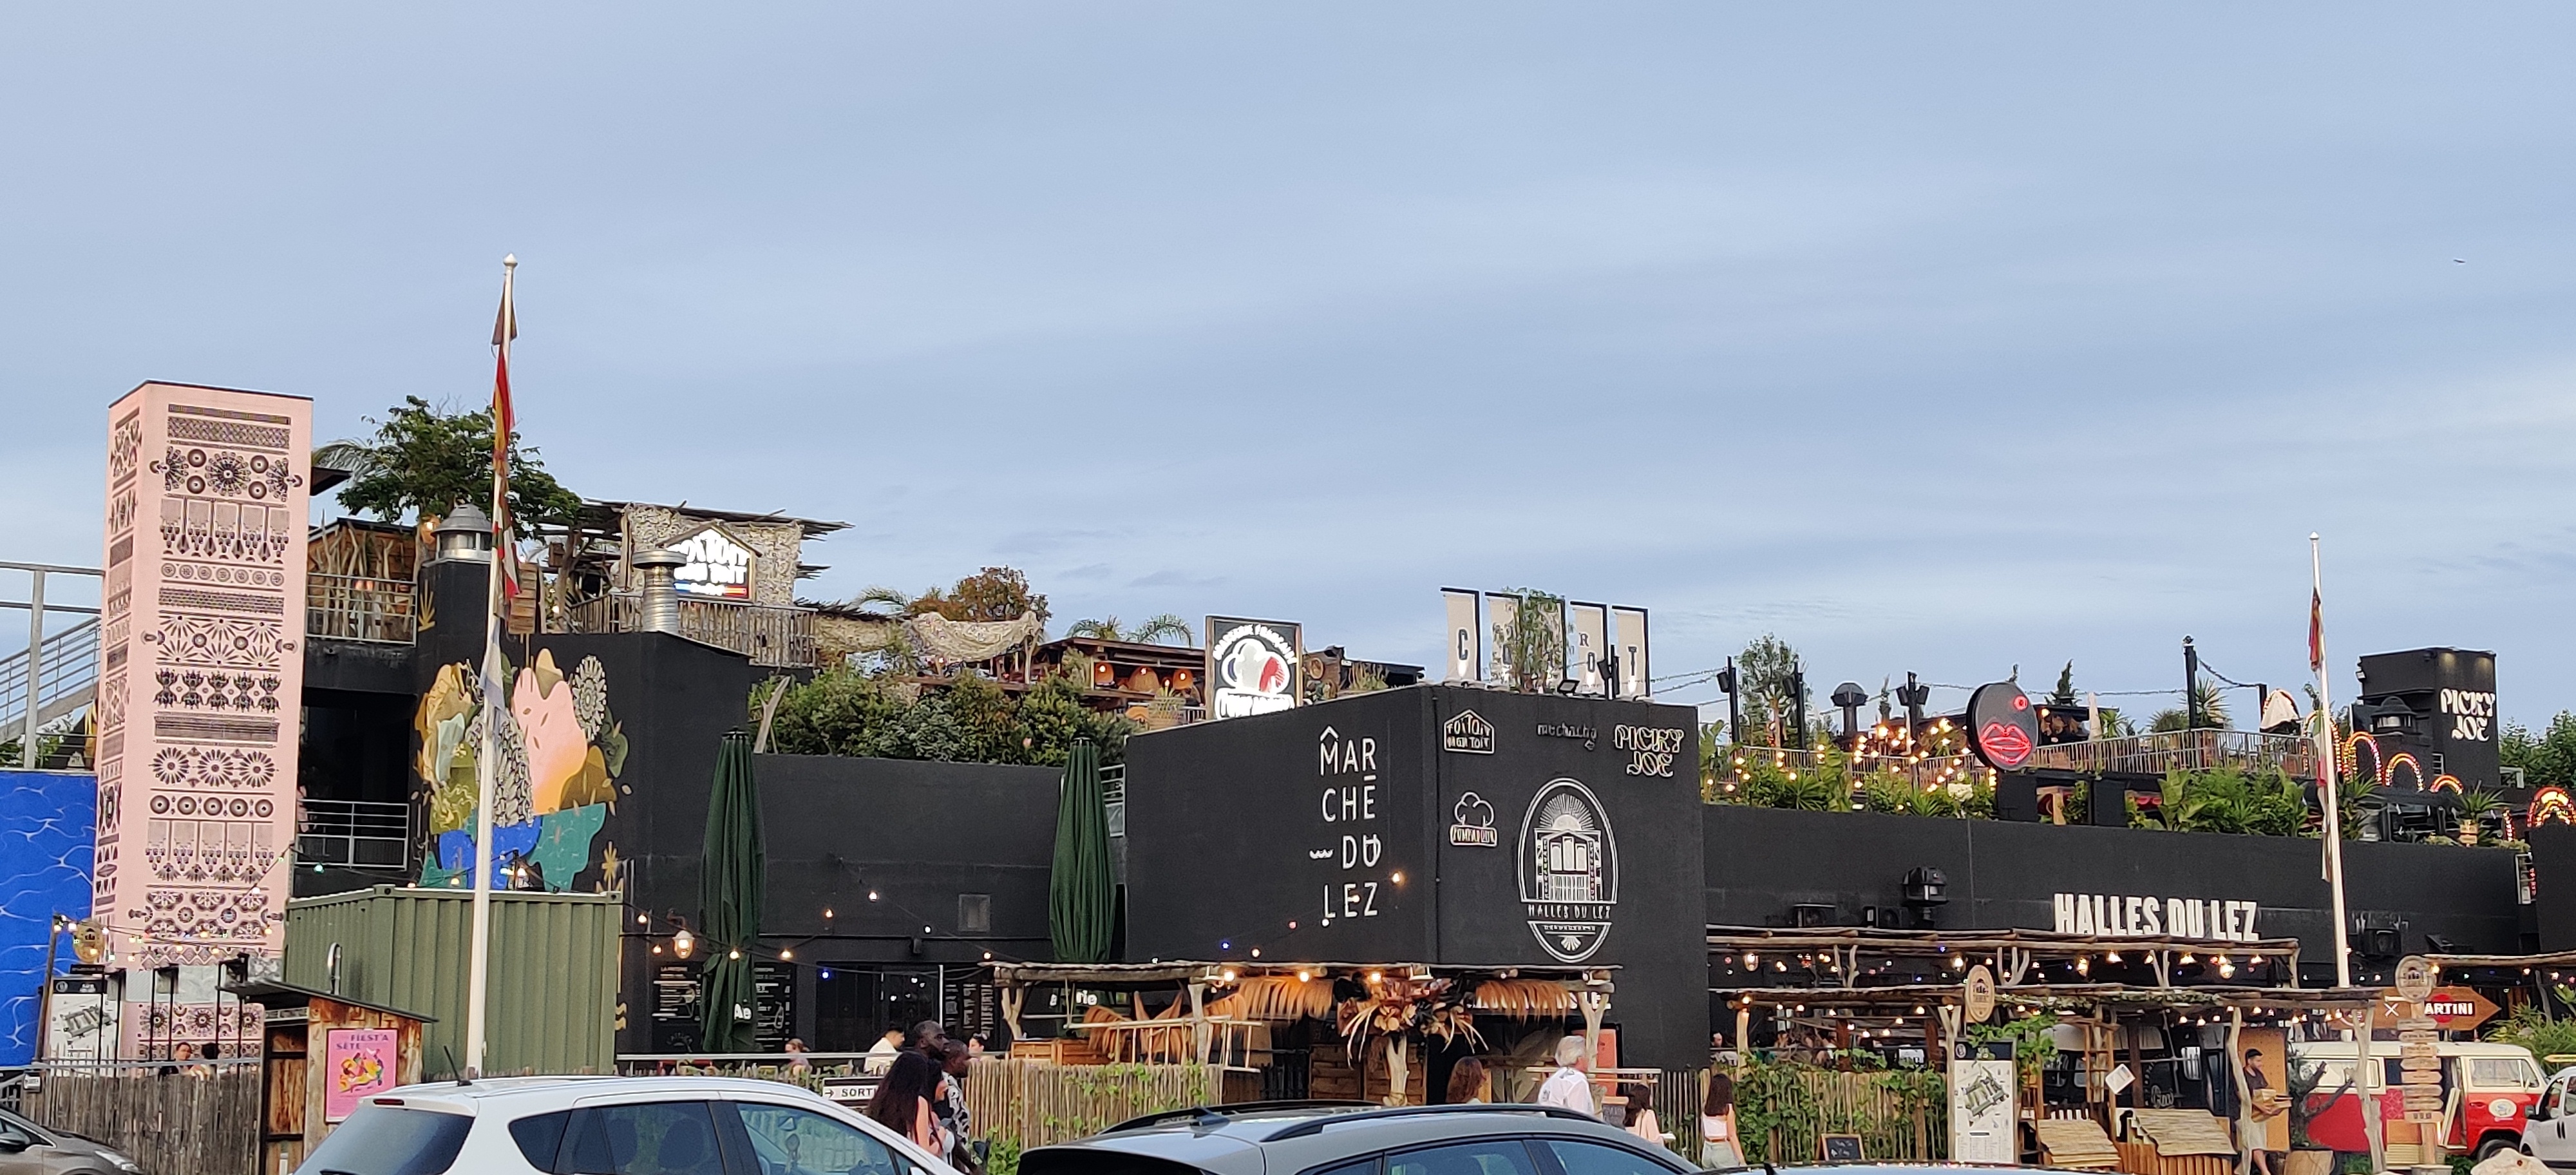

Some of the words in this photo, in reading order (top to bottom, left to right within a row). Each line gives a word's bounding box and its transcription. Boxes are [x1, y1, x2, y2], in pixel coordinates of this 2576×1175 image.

[2440, 688, 2496, 717] PICKY
[1615, 724, 1685, 753] PICKY
[2452, 715, 2490, 741] JOE
[1320, 737, 1377, 776] MAR
[1627, 751, 1674, 778] JOE
[1324, 882, 1378, 918] LEZ
[1528, 904, 1569, 919] HALLES
[1574, 904, 1587, 919] DU
[2054, 893, 2161, 935] HALLES
[2166, 898, 2204, 938] DU
[2210, 900, 2259, 941] LEZ
[2424, 1002, 2474, 1015] ARTINI
